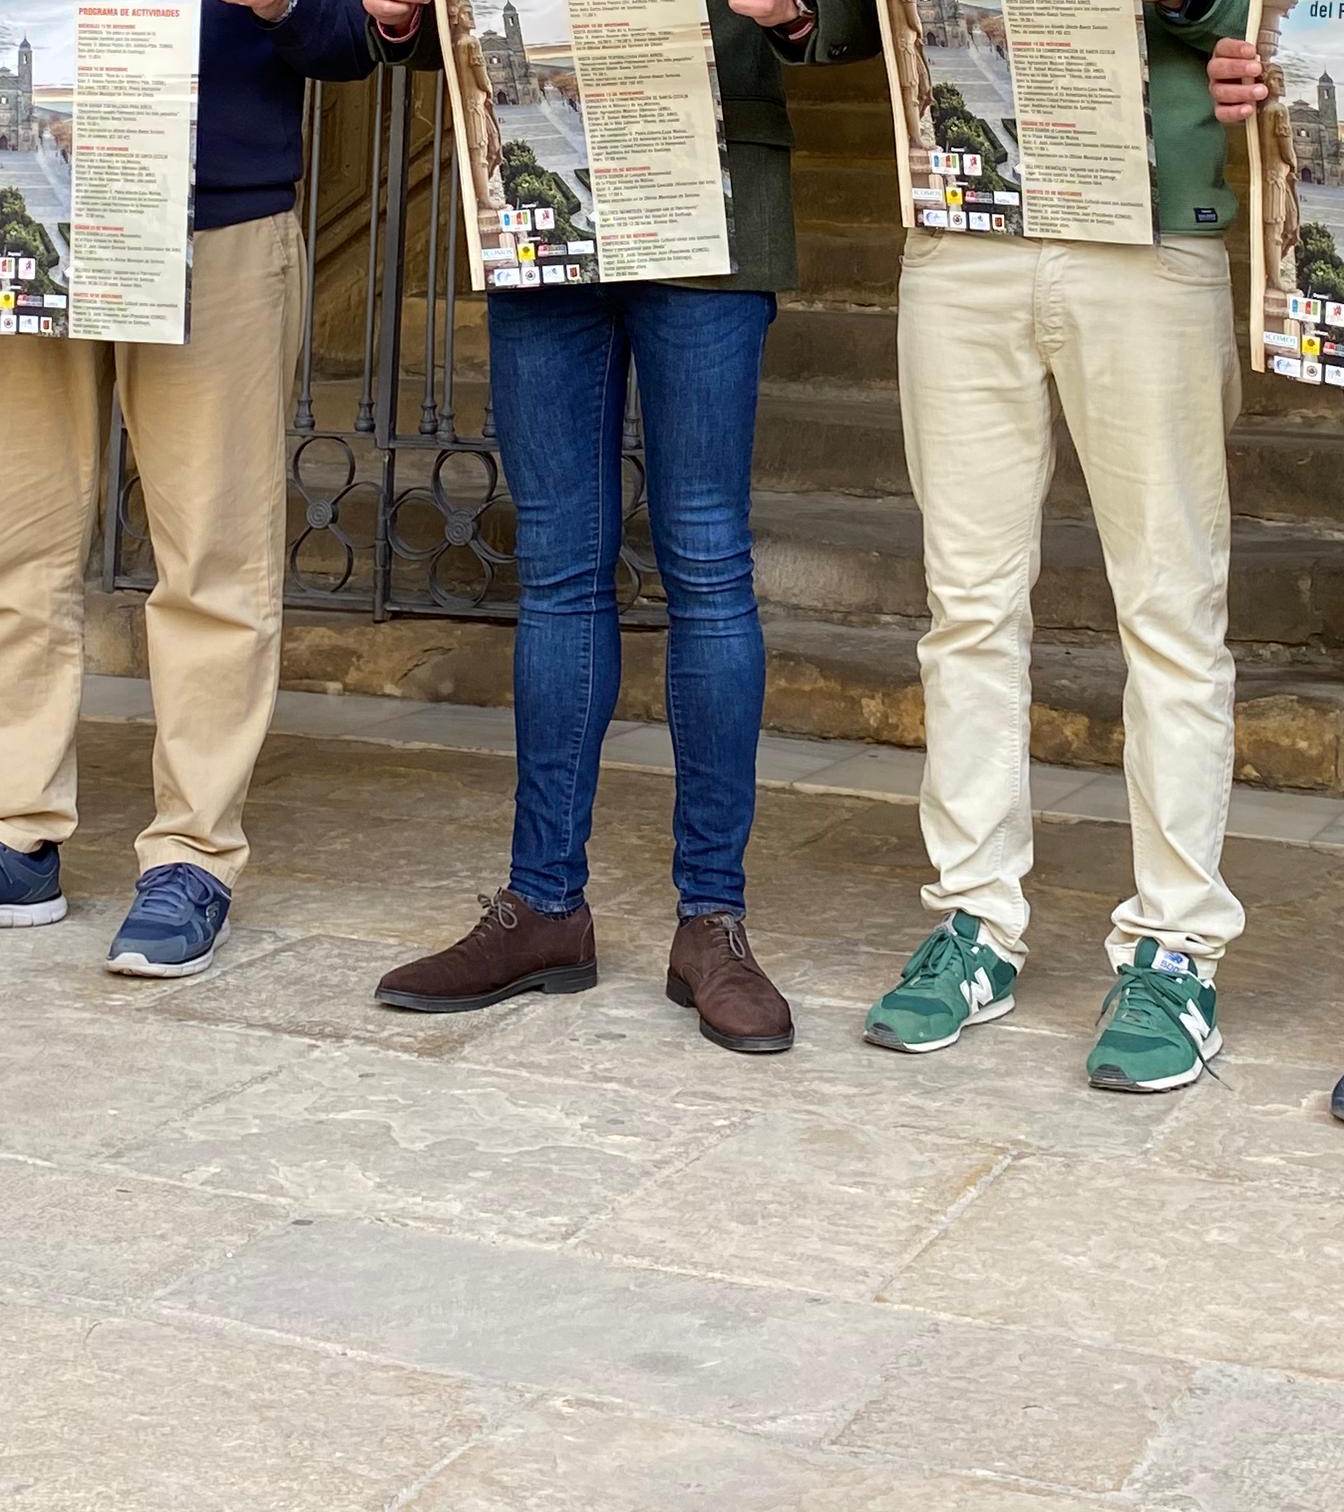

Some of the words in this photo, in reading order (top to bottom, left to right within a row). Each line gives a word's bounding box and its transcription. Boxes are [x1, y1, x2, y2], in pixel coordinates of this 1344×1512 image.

[78, 7, 118, 16] PROGRAMA
[120, 8, 130, 16] DE
[132, 8, 180, 18] ACTIVIDADES
[1310, 1, 1332, 18] del
